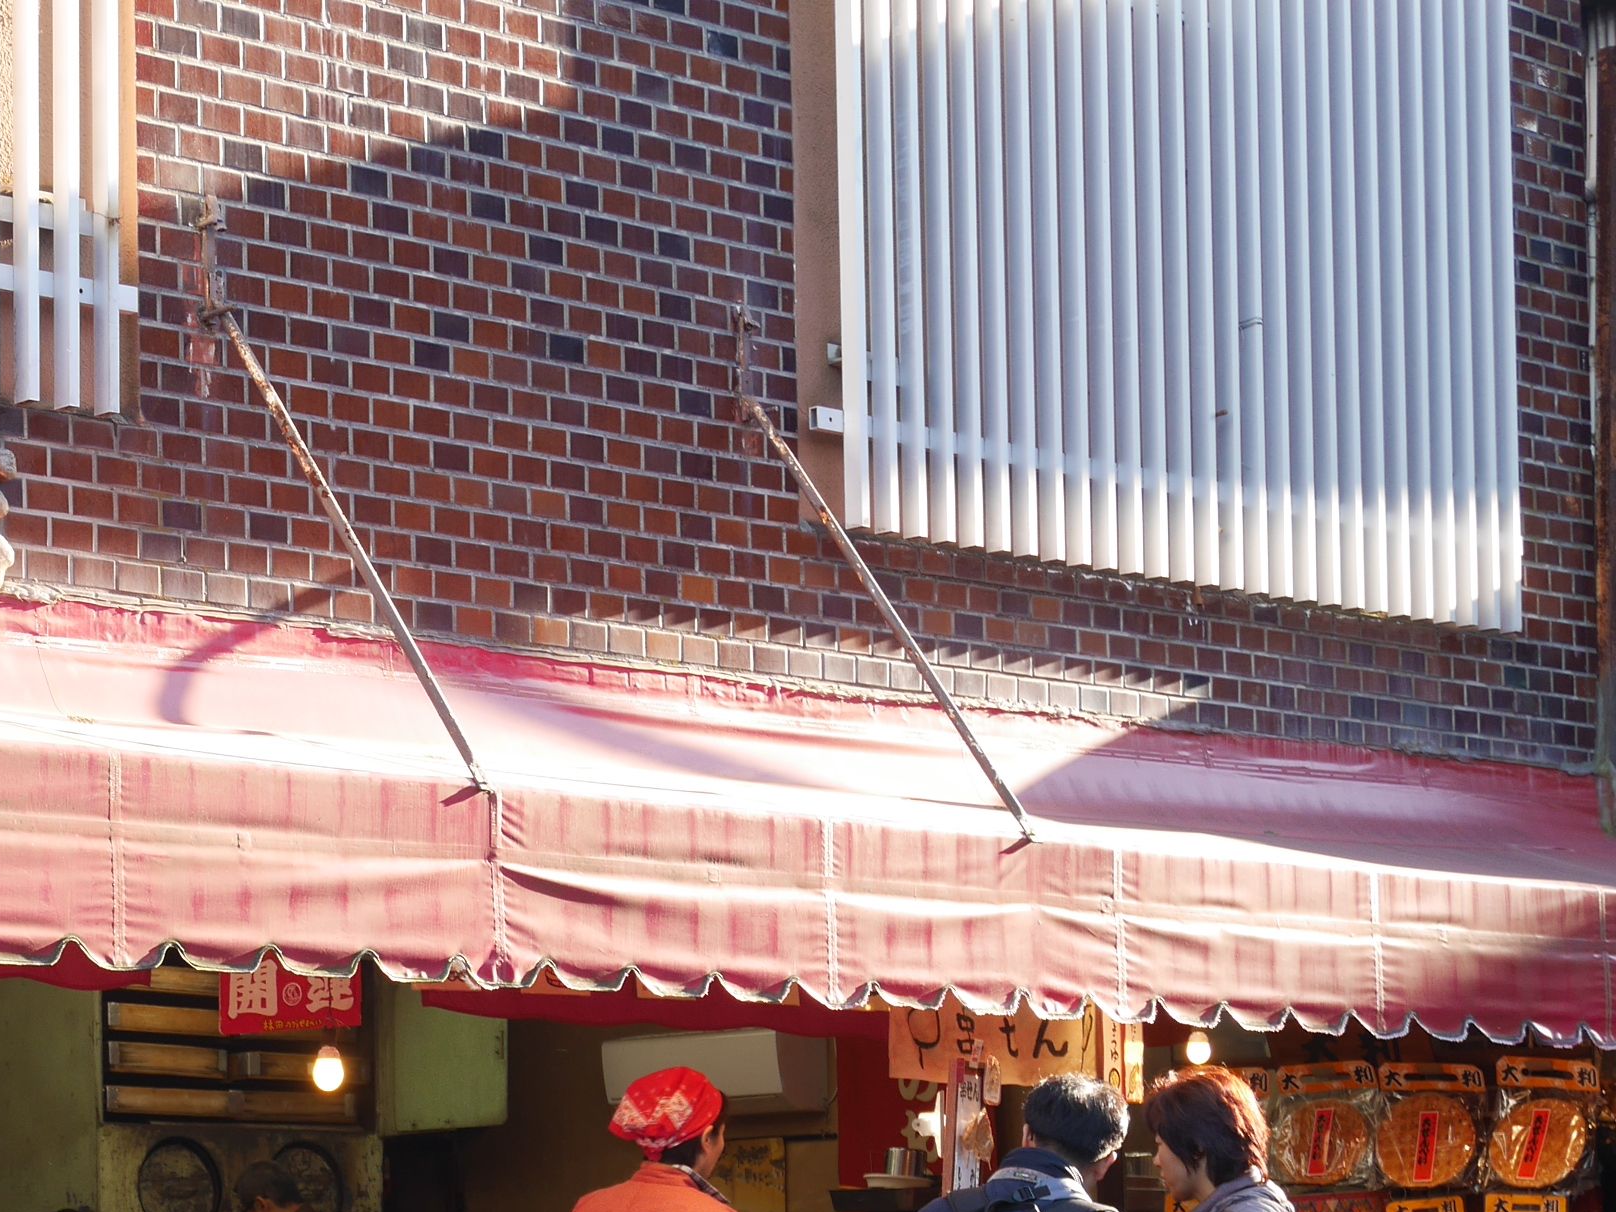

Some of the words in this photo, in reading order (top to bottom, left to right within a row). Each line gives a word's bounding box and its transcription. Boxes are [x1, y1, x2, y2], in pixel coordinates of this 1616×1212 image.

[1282, 1067, 1374, 1090] 大判
[1384, 1069, 1482, 1088] 大判
[1500, 1064, 1597, 1087] 大判
